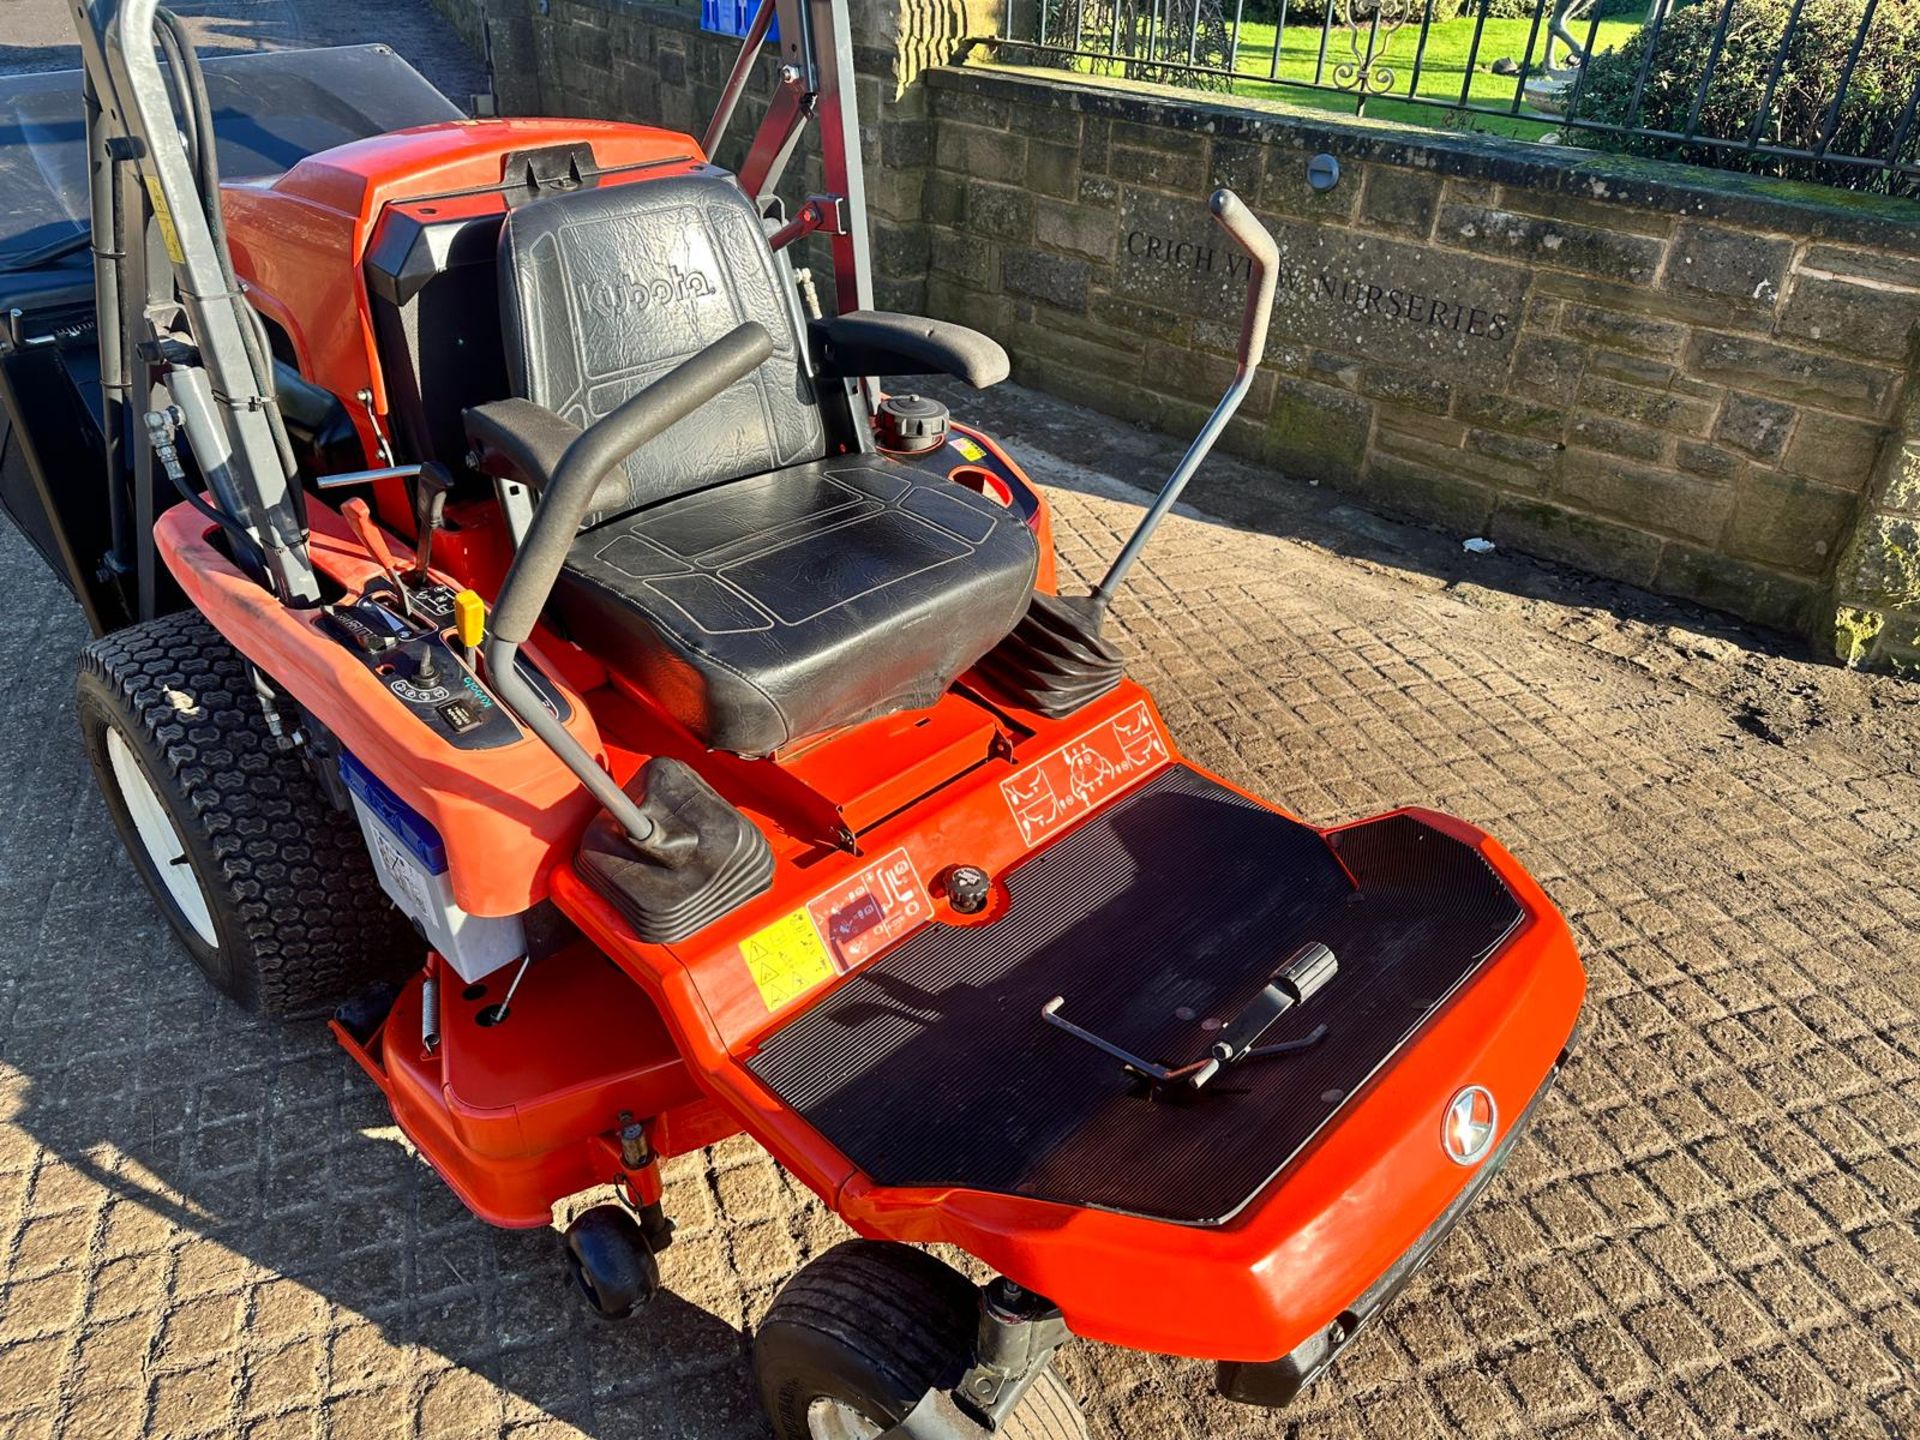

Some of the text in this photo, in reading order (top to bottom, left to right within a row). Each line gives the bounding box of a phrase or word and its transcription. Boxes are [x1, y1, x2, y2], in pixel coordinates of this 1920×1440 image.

[577, 265, 712, 318] Kubota
[1127, 231, 1509, 341] CRICH VIW NURSERIES
